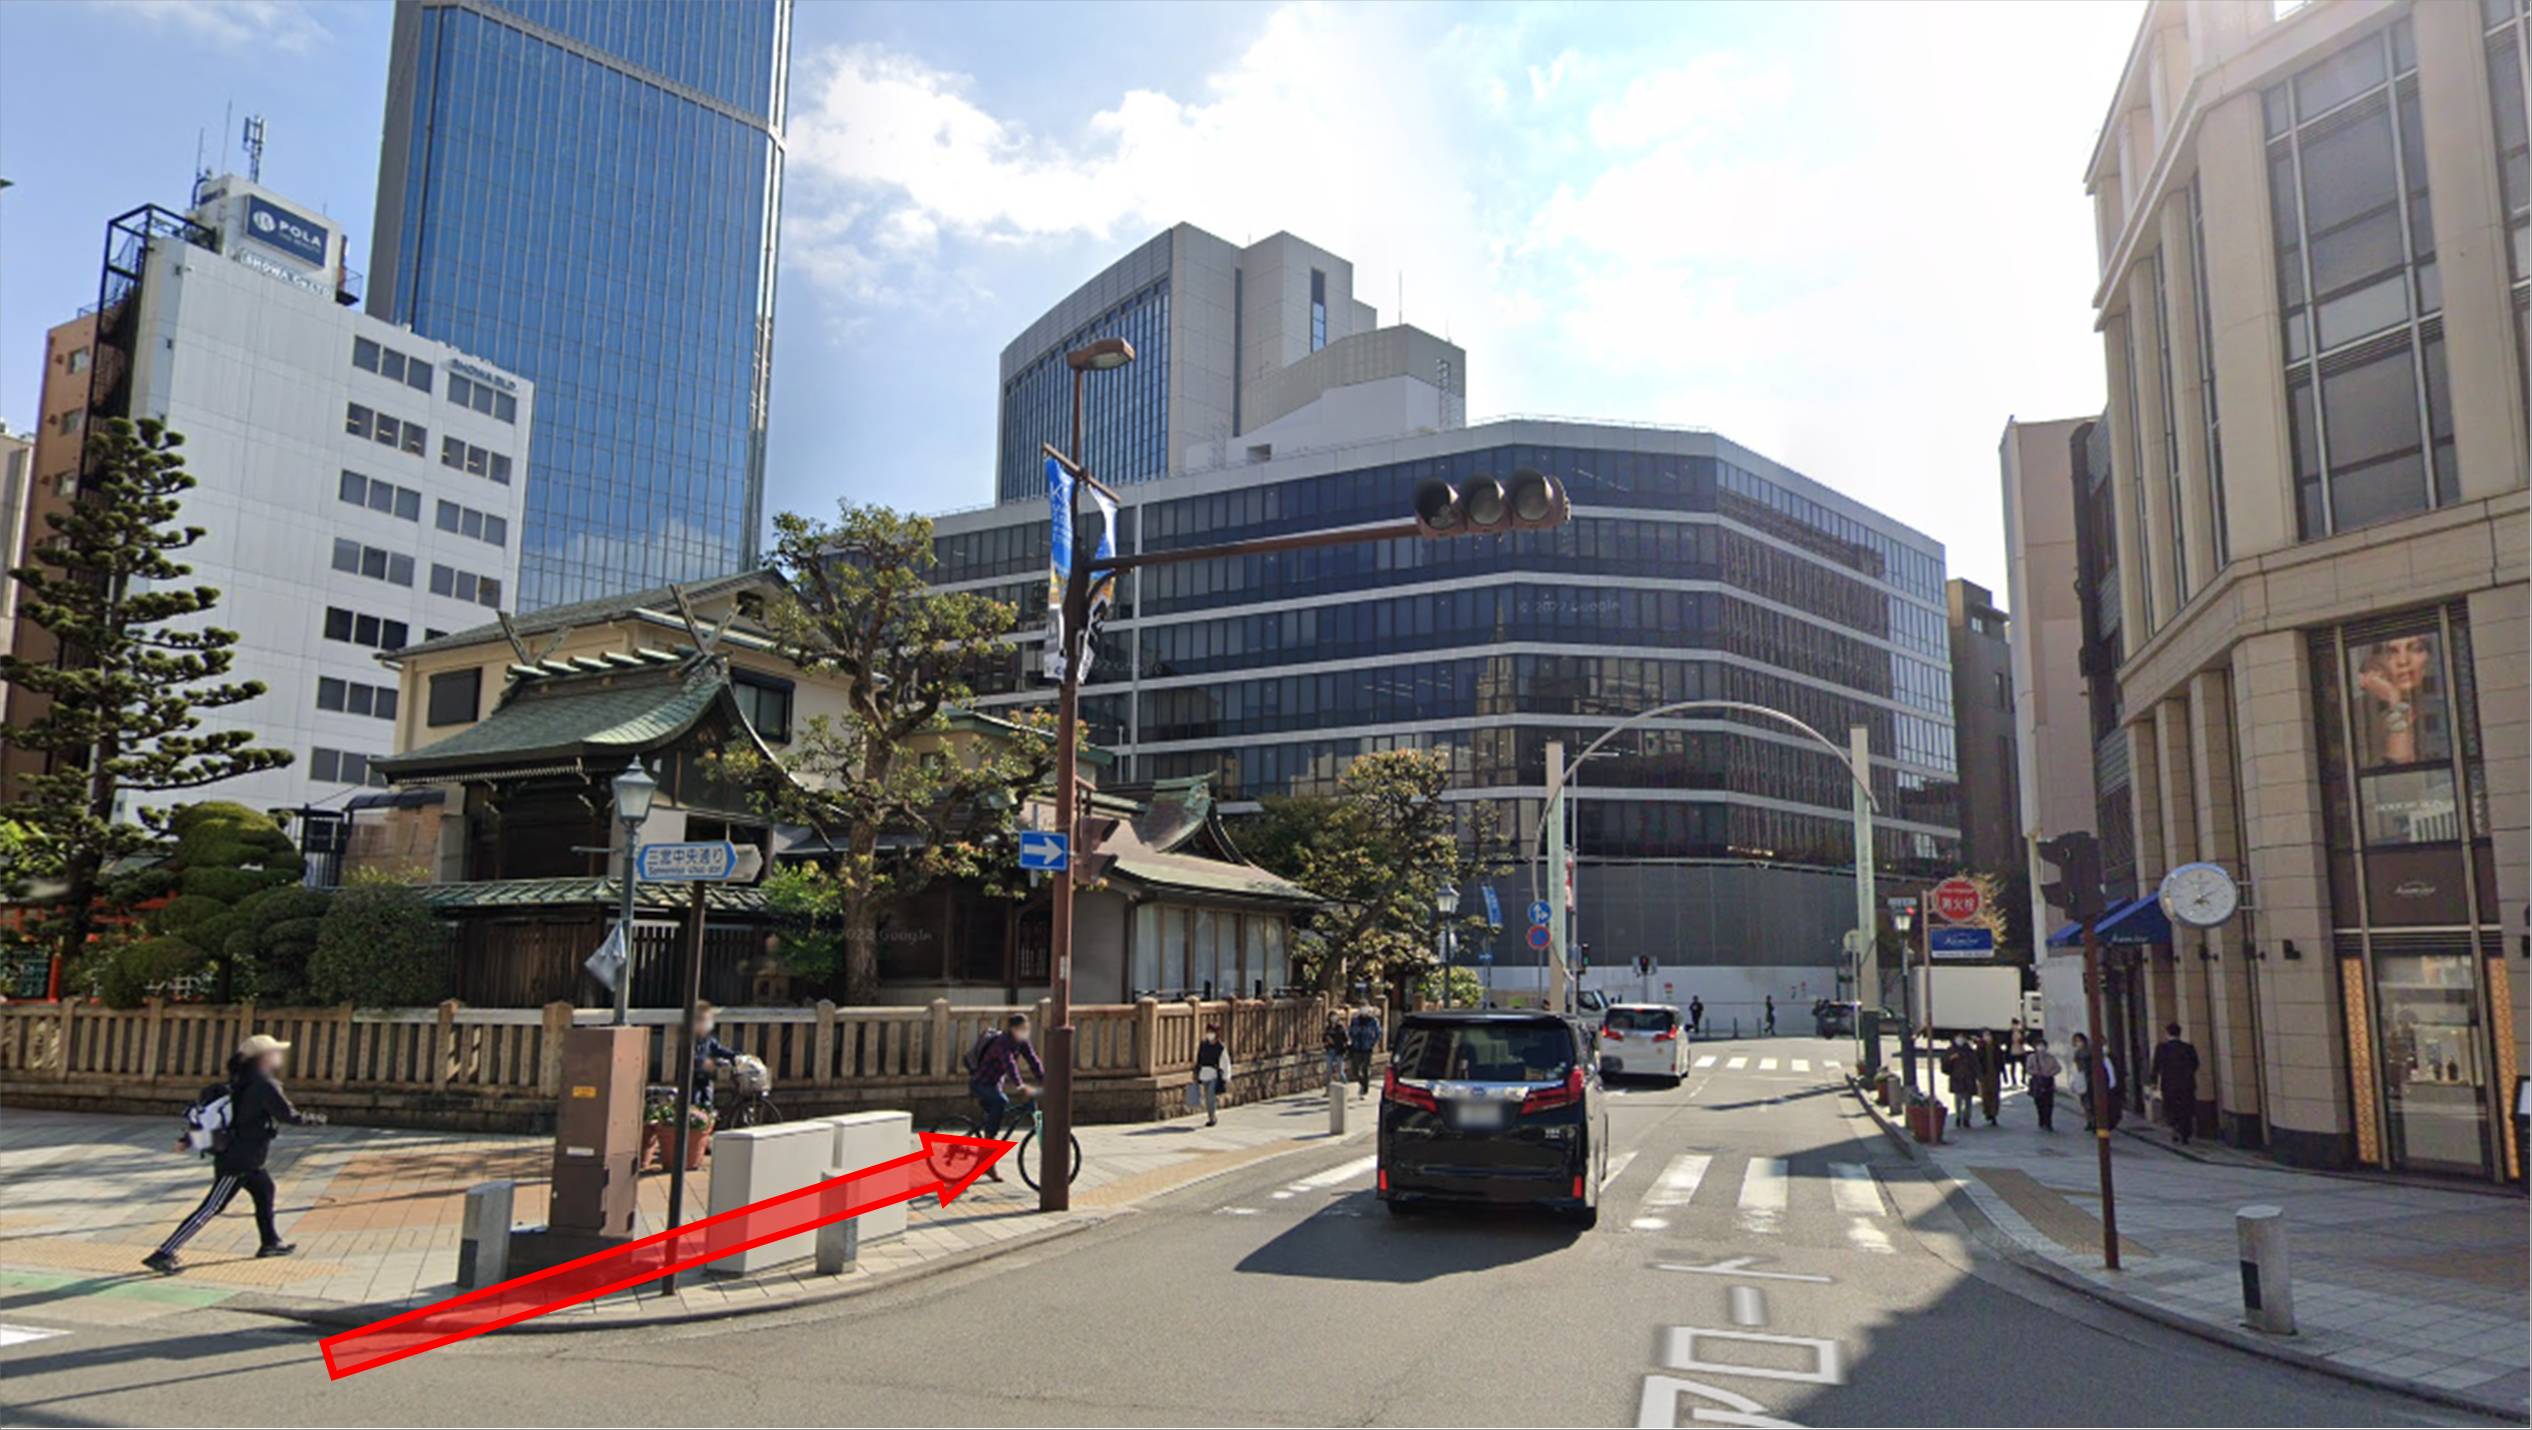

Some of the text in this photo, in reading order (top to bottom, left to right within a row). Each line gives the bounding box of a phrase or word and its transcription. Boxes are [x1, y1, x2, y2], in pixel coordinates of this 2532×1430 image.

[279, 220, 321, 247] POLA
[246, 253, 289, 280] SHOWA
[646, 847, 723, 866] 三宮中央通り
